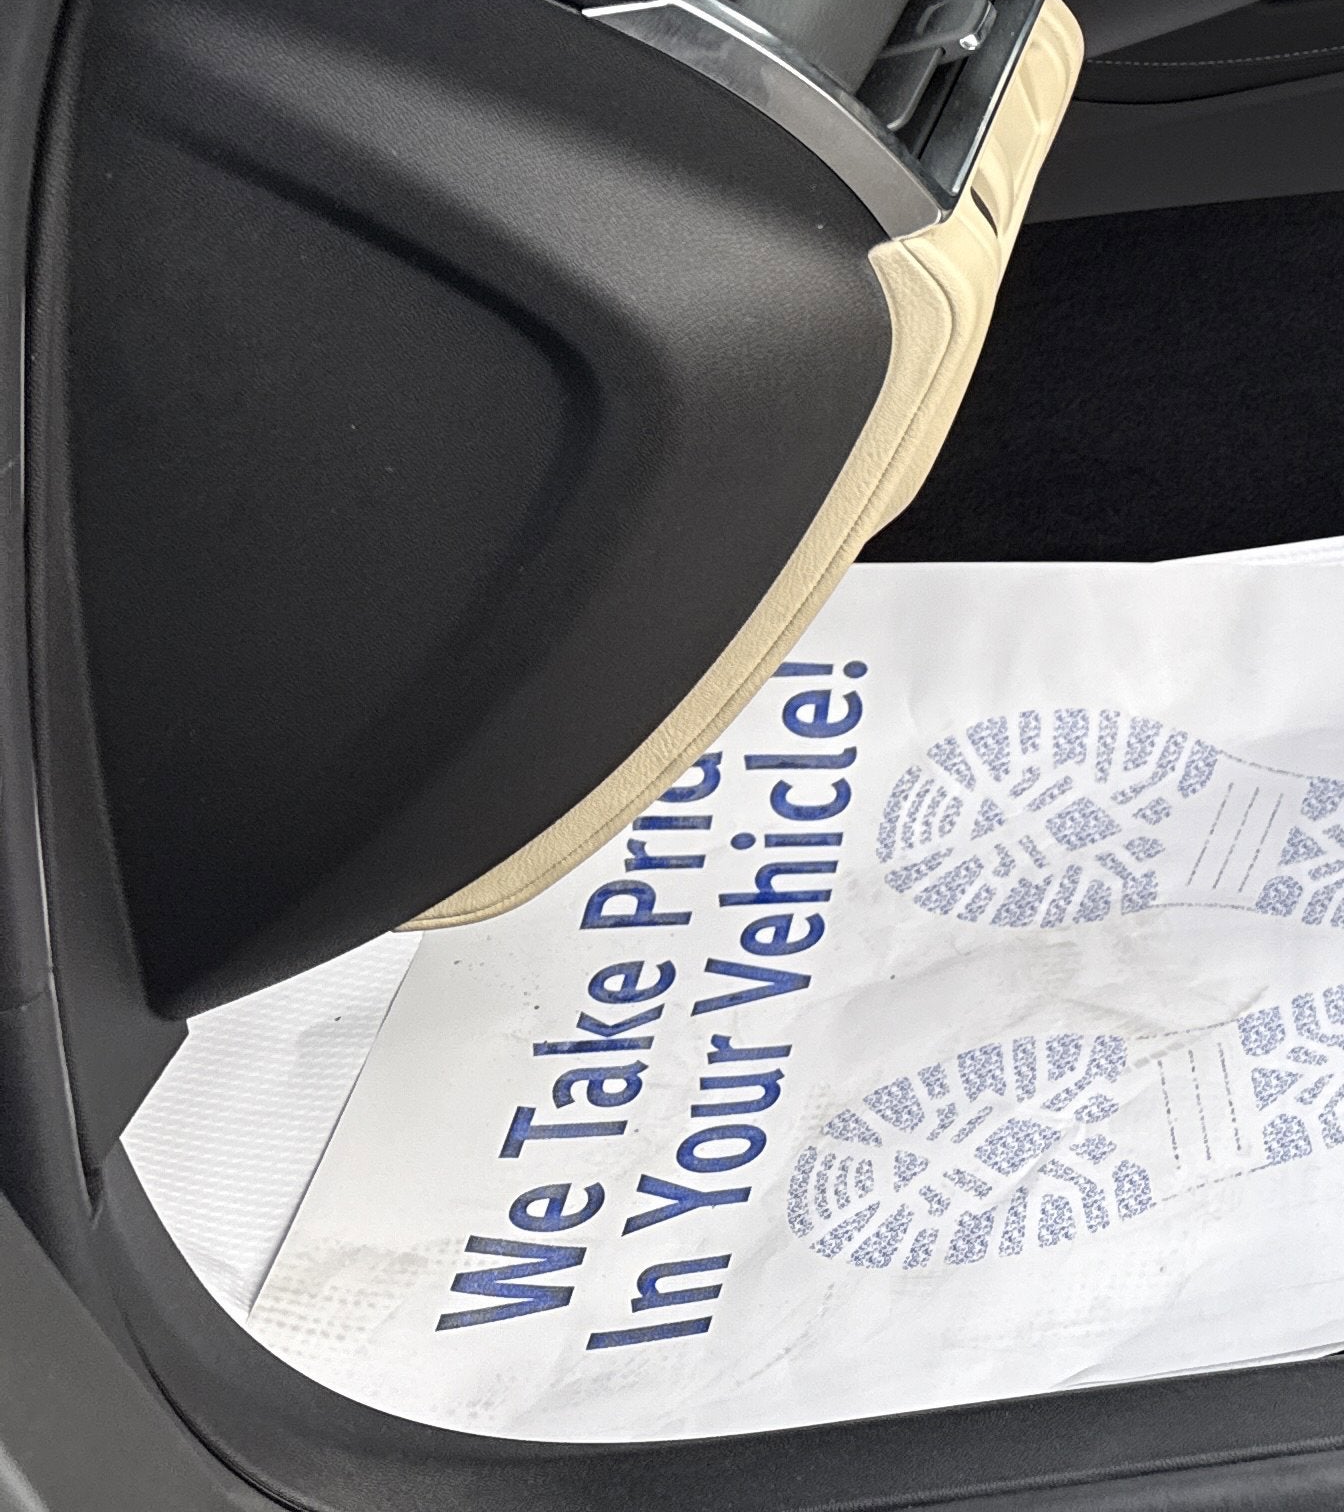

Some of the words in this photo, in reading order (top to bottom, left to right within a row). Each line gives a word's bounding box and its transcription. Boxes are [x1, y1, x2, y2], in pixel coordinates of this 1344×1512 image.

[690, 660, 869, 1018] Vehicle!
[497, 959, 678, 1159] Take
[621, 1033, 794, 1237] Your
[434, 1181, 606, 1333] We
[585, 1253, 733, 1351] In
